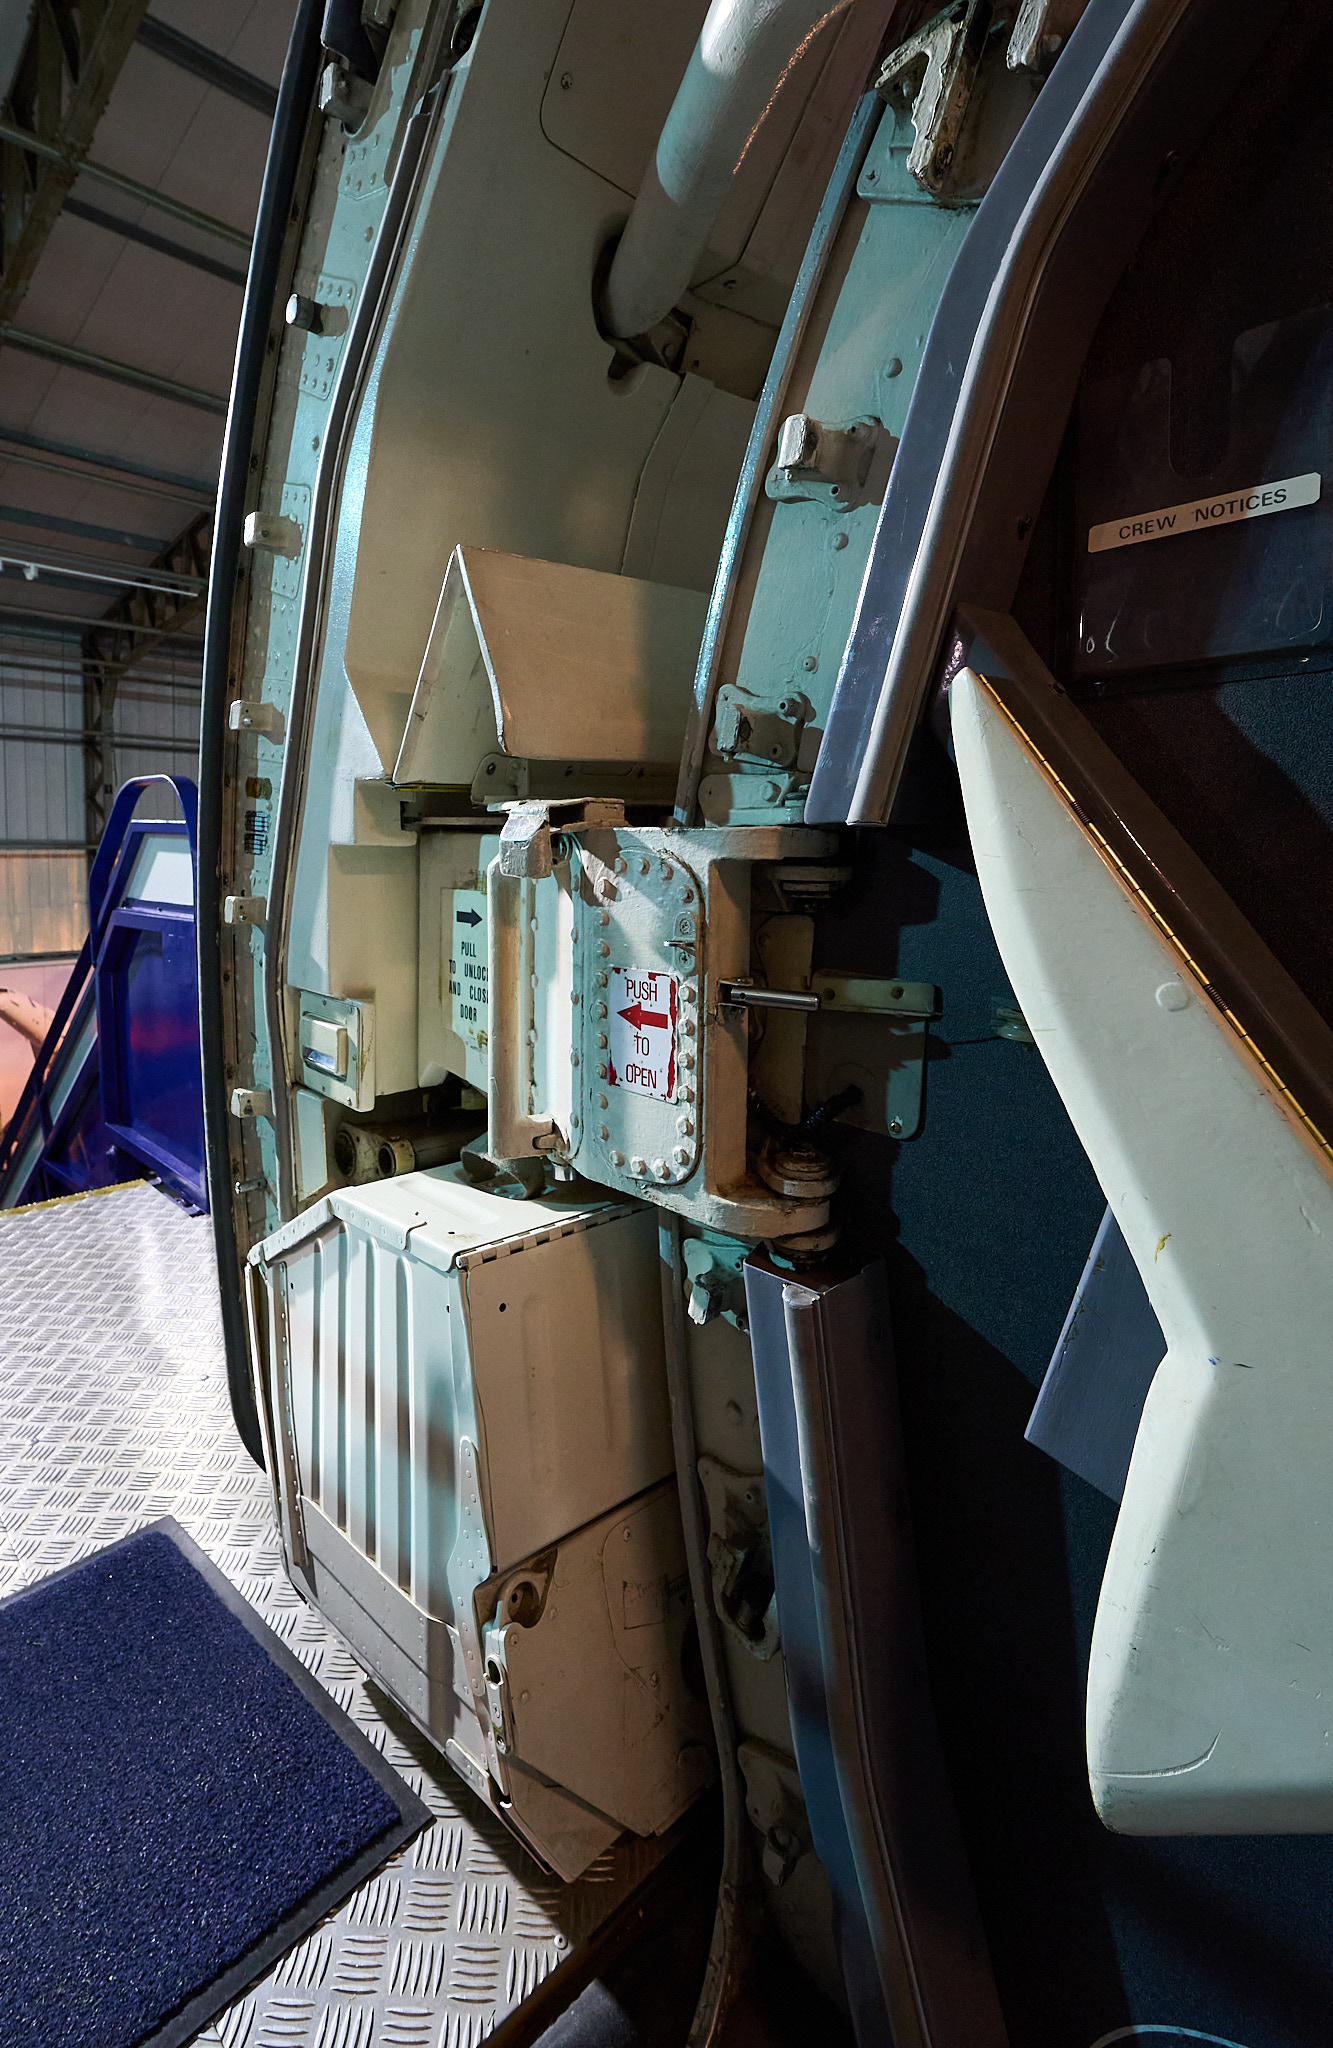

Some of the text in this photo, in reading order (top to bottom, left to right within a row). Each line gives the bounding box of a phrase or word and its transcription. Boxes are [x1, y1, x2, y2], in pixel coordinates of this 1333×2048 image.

[1119, 489, 1287, 540] CREW NOTICES
[461, 941, 477, 958] PULL
[449, 959, 488, 982] TO UNLOC
[449, 980, 488, 1004] AND CLOS
[626, 979, 657, 1002] PUSH
[460, 1004, 477, 1022] DOOR
[634, 1032, 649, 1056] TO
[626, 1063, 657, 1089] OPEN
